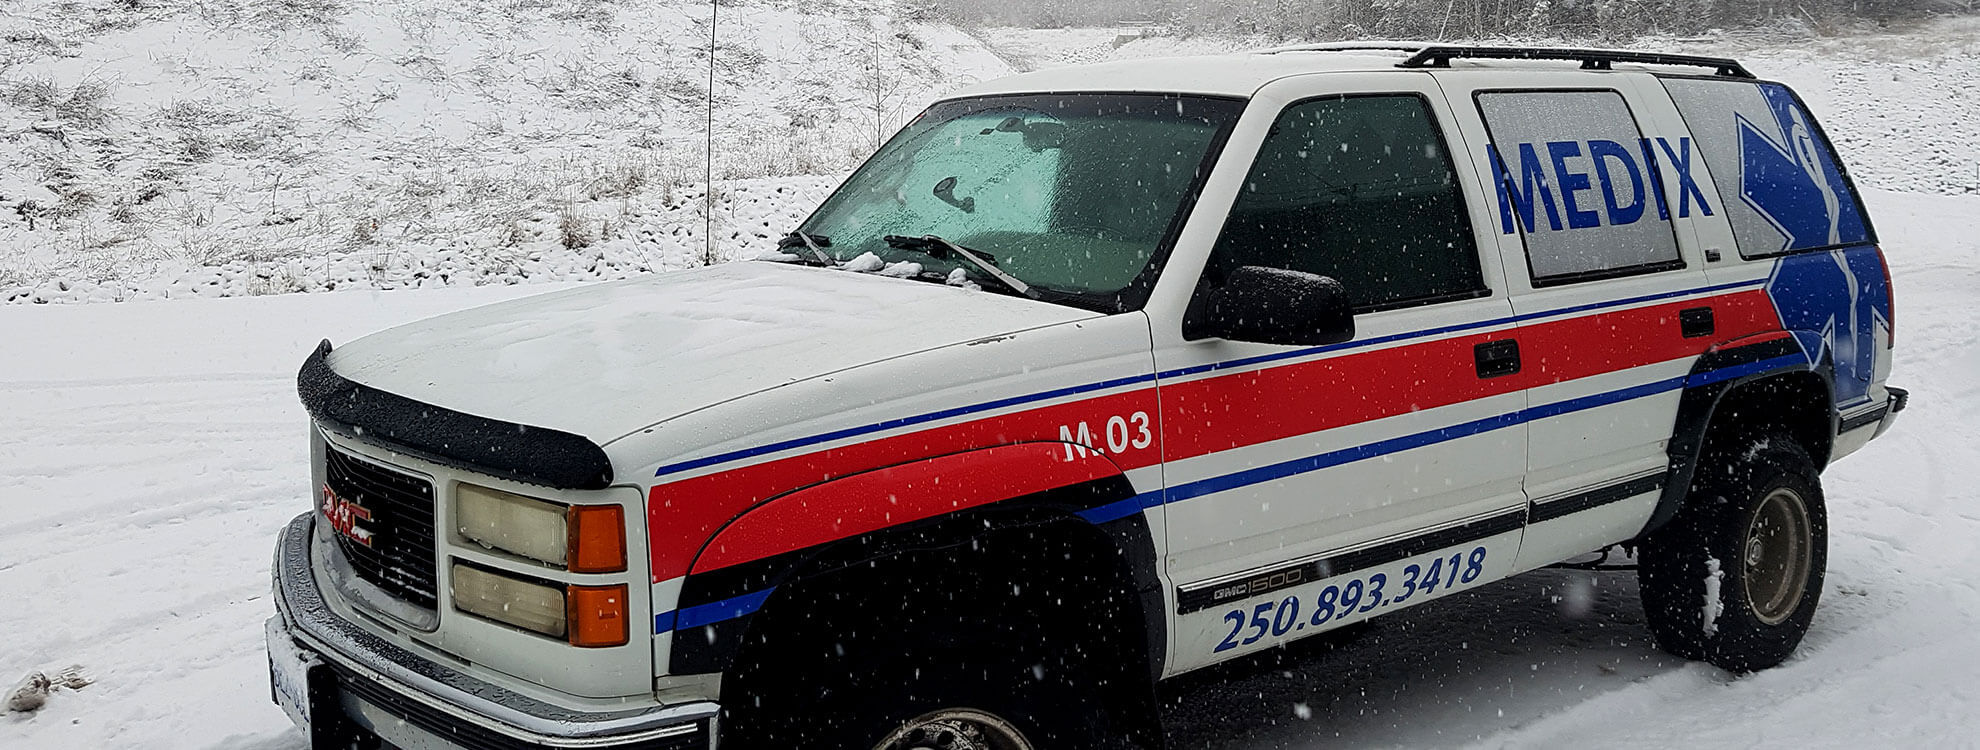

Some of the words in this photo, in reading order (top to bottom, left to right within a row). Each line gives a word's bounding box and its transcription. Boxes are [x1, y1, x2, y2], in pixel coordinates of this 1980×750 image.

[1487, 137, 1713, 235] MEDIX
[1060, 411, 1152, 462] M.03
[1213, 547, 1487, 653] 250.893.3418
